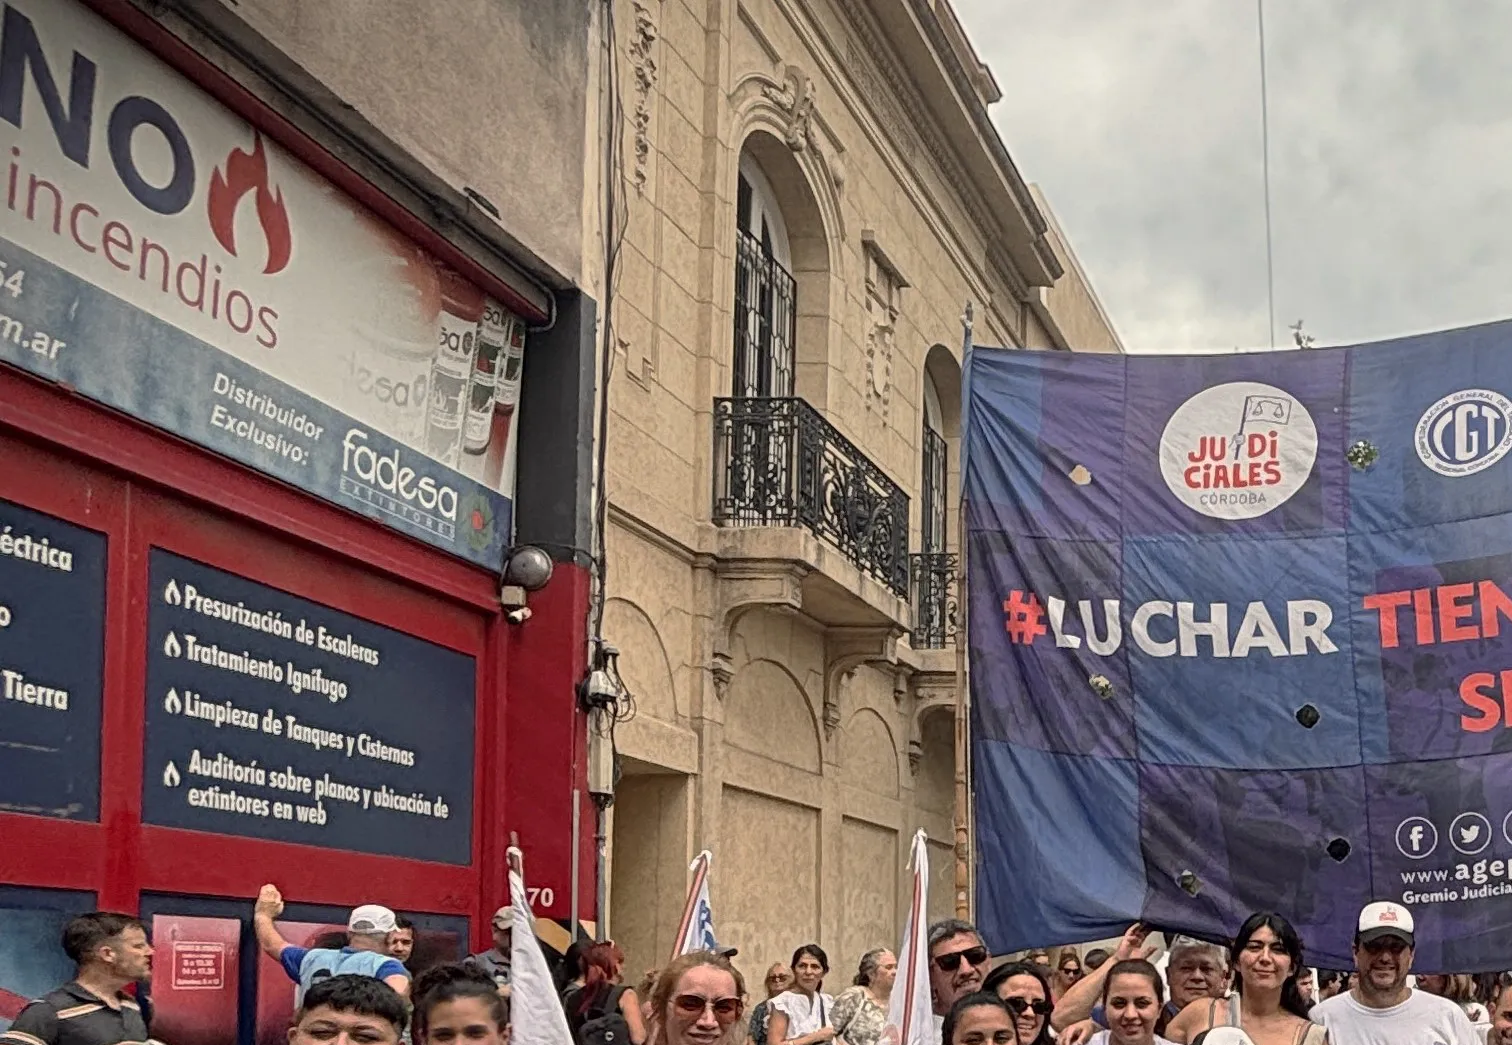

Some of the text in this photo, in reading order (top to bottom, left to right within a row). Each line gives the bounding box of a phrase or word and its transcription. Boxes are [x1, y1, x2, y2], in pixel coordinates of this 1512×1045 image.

[0, 5, 196, 217] NO
[7, 147, 279, 350] incendios
[210, 404, 309, 466] Exclusivo:
[213, 372, 324, 440] Distribuidor
[1433, 403, 1501, 461] CGT
[343, 428, 458, 521] fadesa
[1200, 490, 1267, 505] CÓRDOBA
[184, 583, 380, 666] Presurización de Escaleras
[1003, 589, 1338, 658] #LUCHAR
[2, 669, 68, 711] Tierra
[184, 634, 348, 703] Tratamiento Ignífugo
[184, 690, 415, 767] Limpieza de Tanques y Cisternas
[188, 749, 449, 819] Auditoría sobre planos y ubicación de
[188, 786, 327, 826] extintores en web
[526, 887, 554, 908] 70
[1402, 888, 1459, 905] Gremio
